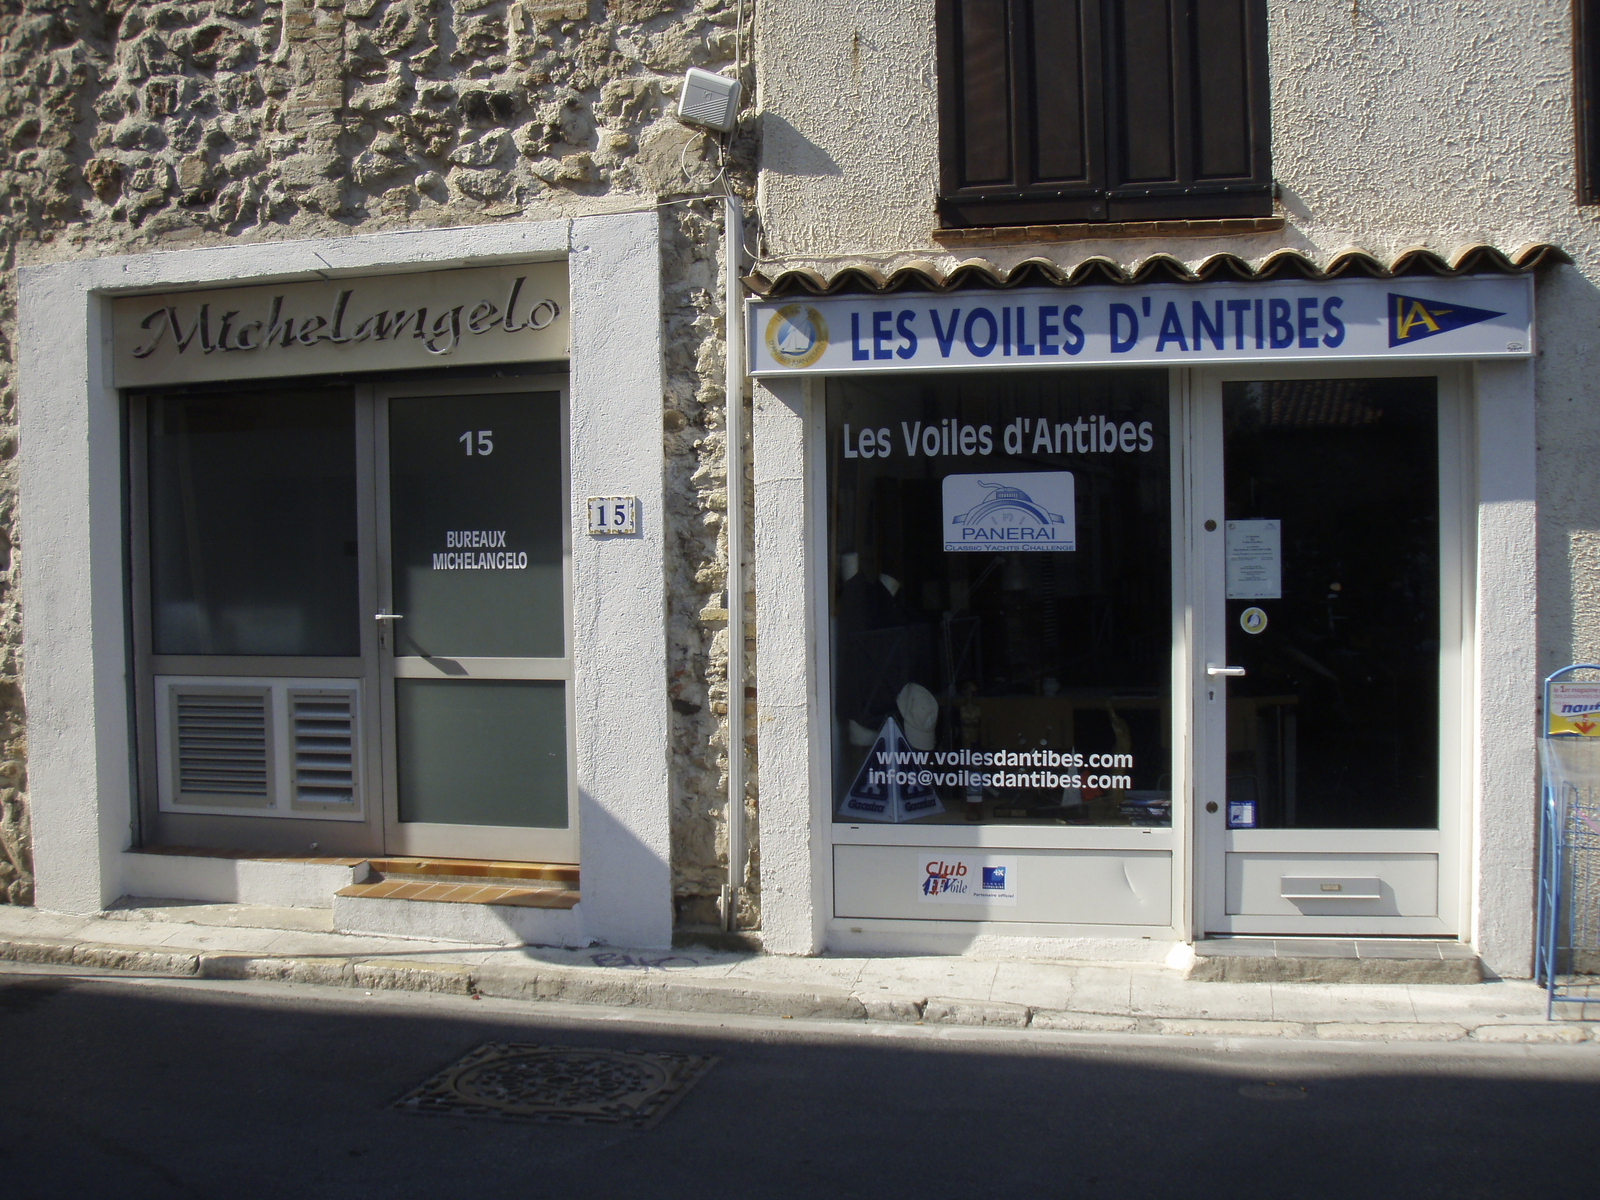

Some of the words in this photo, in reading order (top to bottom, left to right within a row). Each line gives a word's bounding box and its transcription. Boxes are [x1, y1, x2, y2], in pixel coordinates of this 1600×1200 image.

[132, 277, 561, 358] Michelangelo
[851, 309, 918, 361] LES
[930, 304, 1085, 359] VOILES
[1109, 296, 1346, 353] D'ANTIBES
[458, 430, 494, 456] 15
[843, 423, 892, 459] Les
[901, 418, 993, 457] Voiles
[1003, 415, 1154, 456] d'Antibes
[596, 504, 627, 527] 15
[446, 530, 507, 549] BUREAUX
[962, 527, 1055, 540] PANERAI
[432, 551, 528, 571] MICHELANGELO
[876, 750, 1133, 768] www.voilesdantibes.com
[868, 768, 1131, 789] infos@voilesdantibes.com
[925, 861, 967, 877] Club
